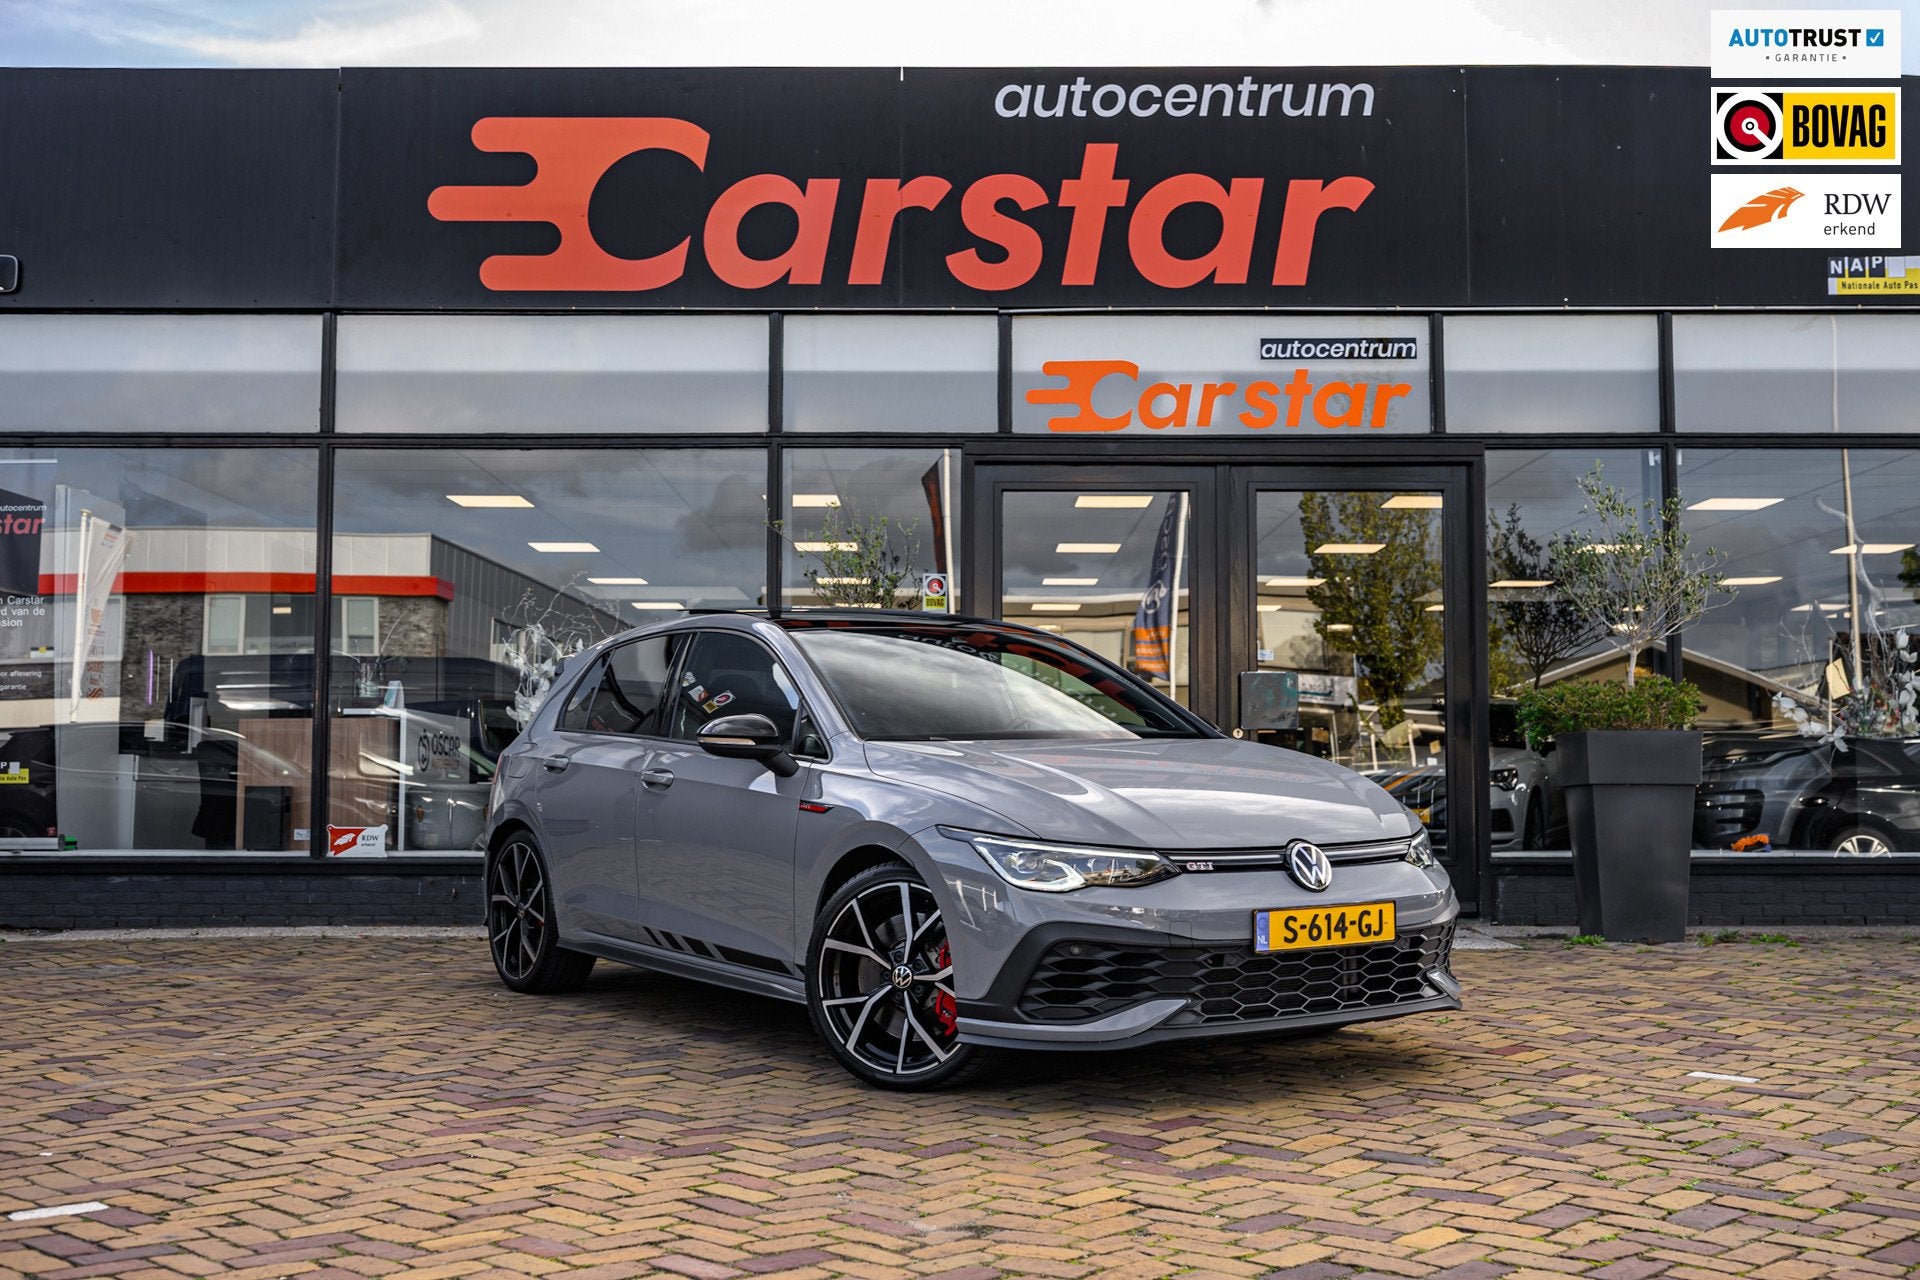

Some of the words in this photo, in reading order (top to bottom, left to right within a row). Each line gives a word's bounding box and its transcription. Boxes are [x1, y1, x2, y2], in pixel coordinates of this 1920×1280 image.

[994, 76, 1376, 118] autocentrum
[427, 116, 1376, 291] Carstar
[1841, 281, 1880, 290] Nationale
[1883, 281, 1902, 290] Auto
[1904, 280, 1918, 289] Pas
[1260, 338, 1417, 359] autocentrum
[1025, 360, 1414, 432] Carstar
[0, 504, 47, 512] utocentrum
[0, 513, 46, 535] tar
[7, 595, 45, 605] Carstar
[11, 608, 29, 616] van
[33, 606, 46, 616] de
[0, 617, 23, 627] sion
[432, 734, 460, 757] OSCAR
[361, 834, 380, 842] RDW
[1186, 861, 1214, 871] GTI
[1257, 934, 1268, 945] NL
[1283, 908, 1385, 944] S-614-GJ
